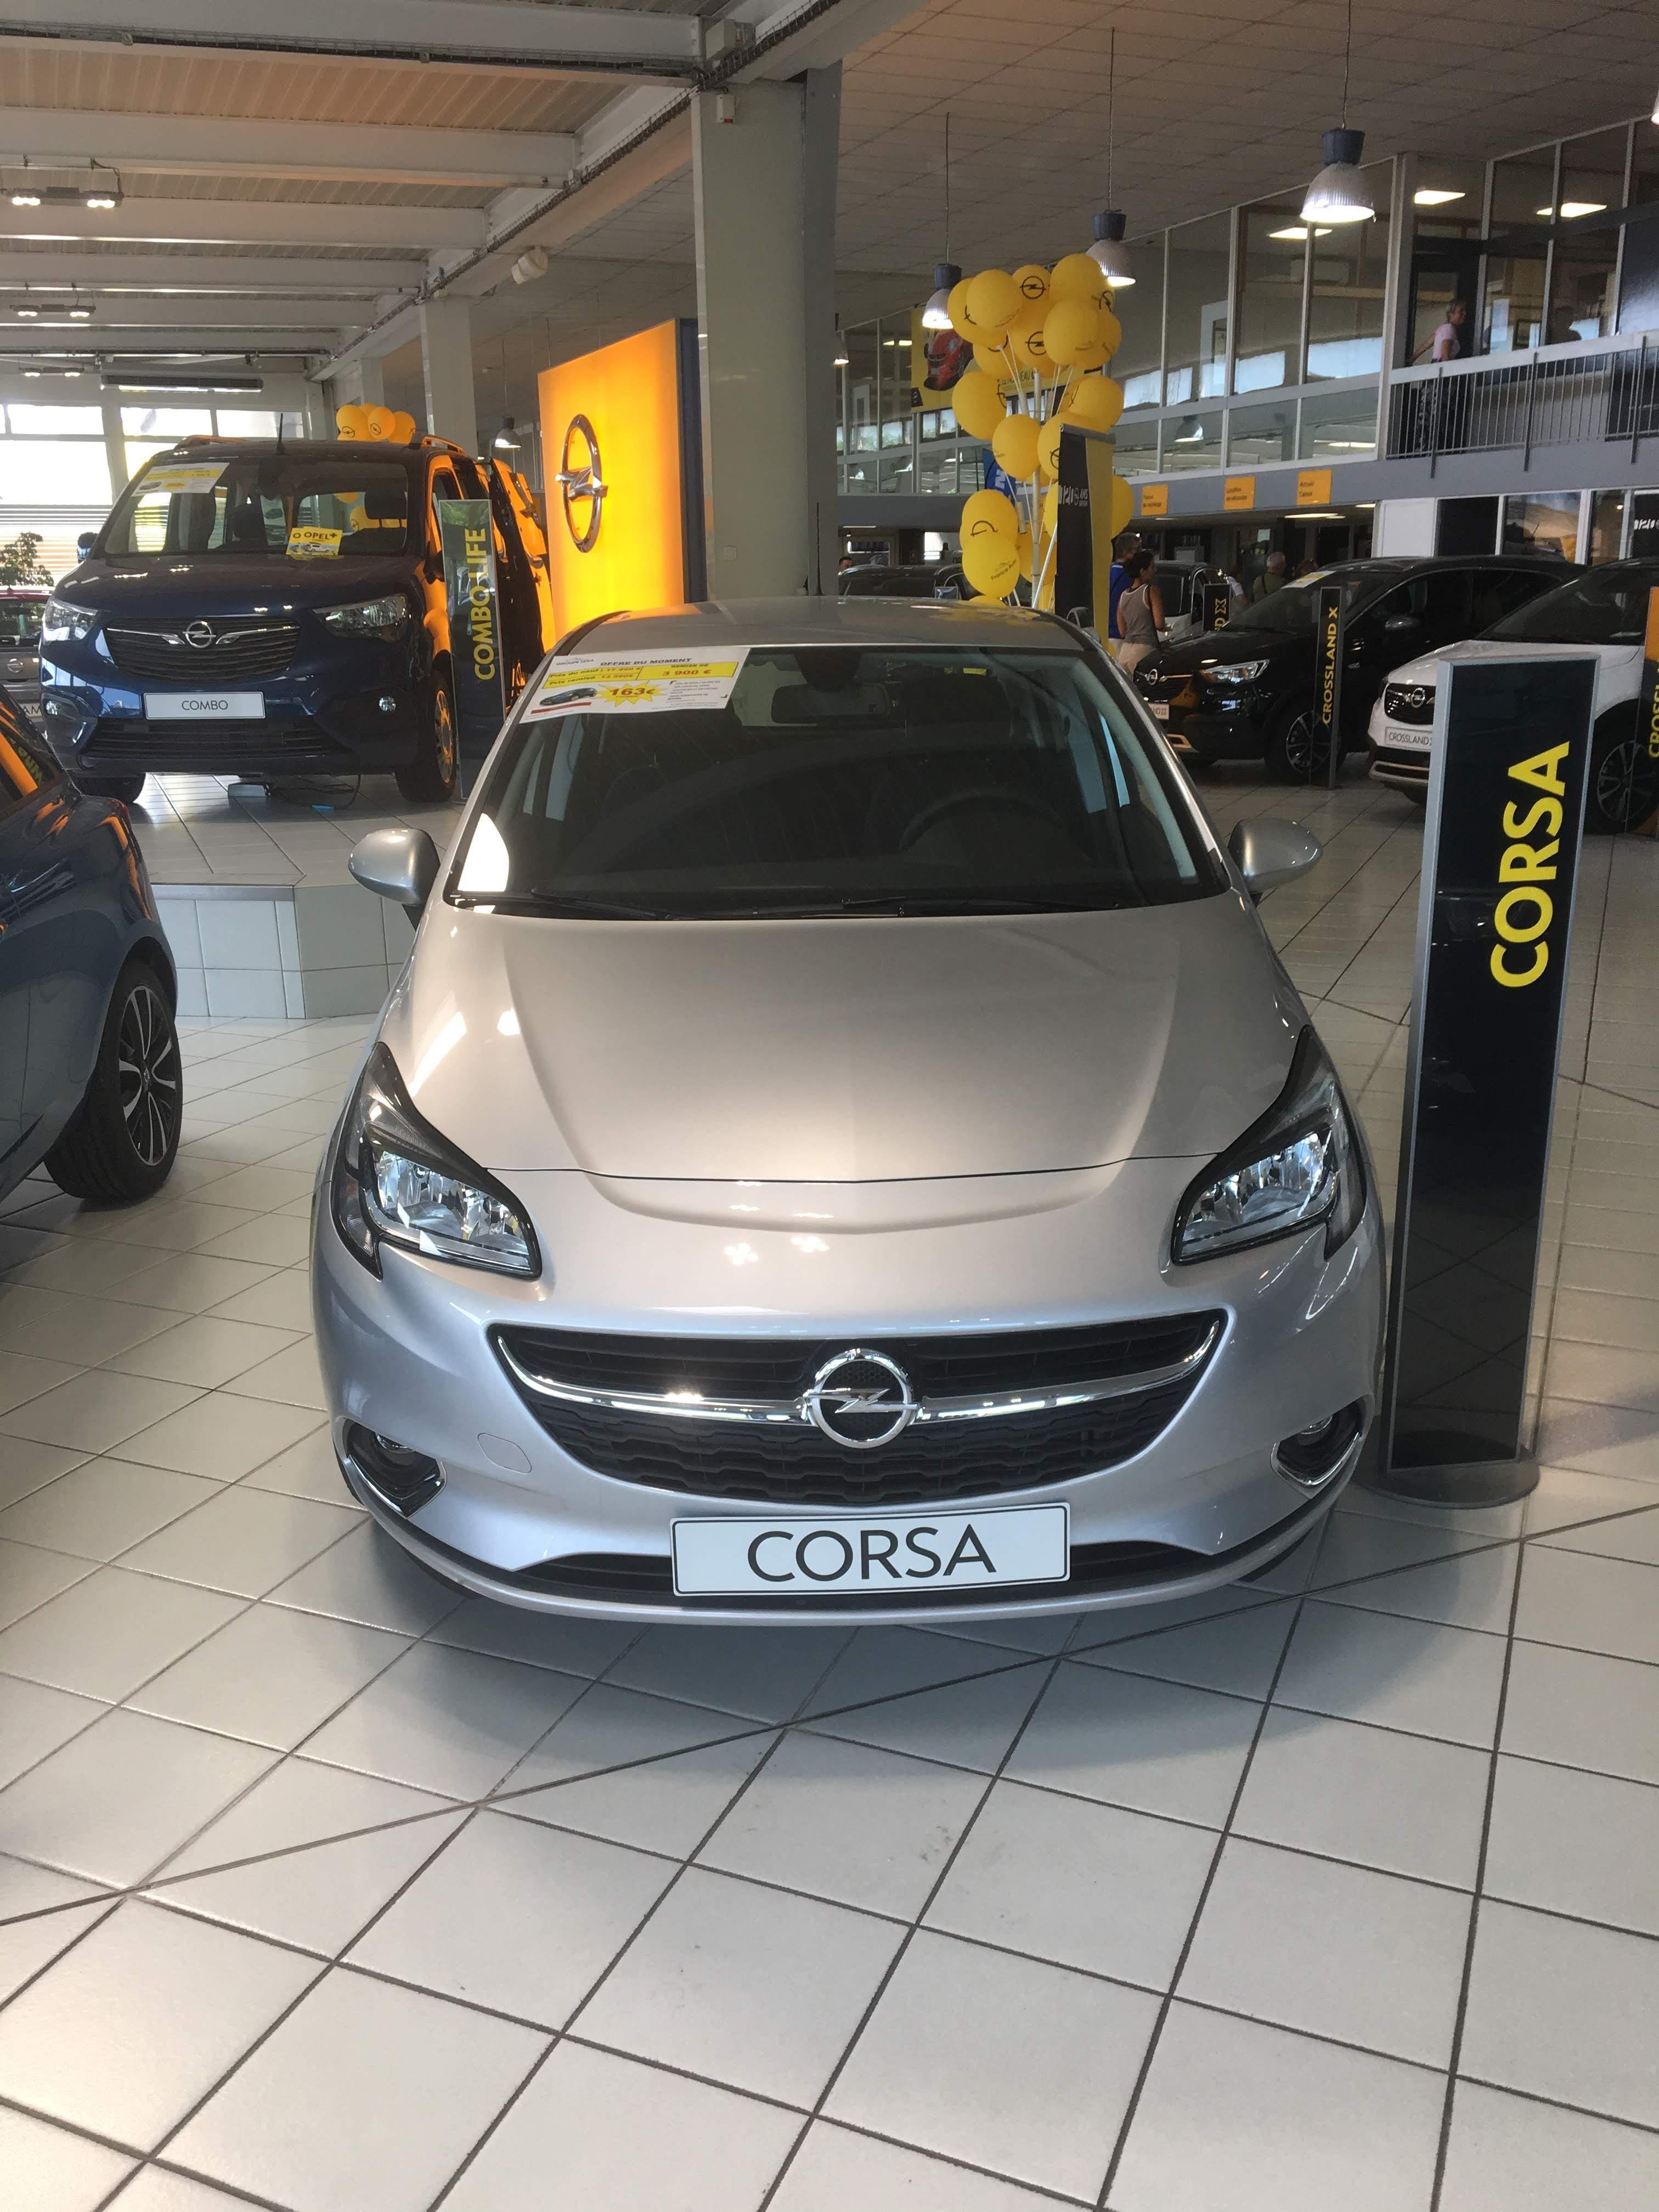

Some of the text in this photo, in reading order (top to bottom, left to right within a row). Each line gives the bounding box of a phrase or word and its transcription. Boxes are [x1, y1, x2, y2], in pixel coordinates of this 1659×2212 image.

[464, 528, 495, 680] COMBO LIFE
[610, 687, 655, 696] 163€
[1322, 606, 1339, 724] CROSSLAND X
[182, 700, 228, 710] COMBO
[1389, 732, 1429, 746] CROSSLAND
[1490, 741, 1570, 988] CORSA
[747, 1523, 997, 1582] CORSA
